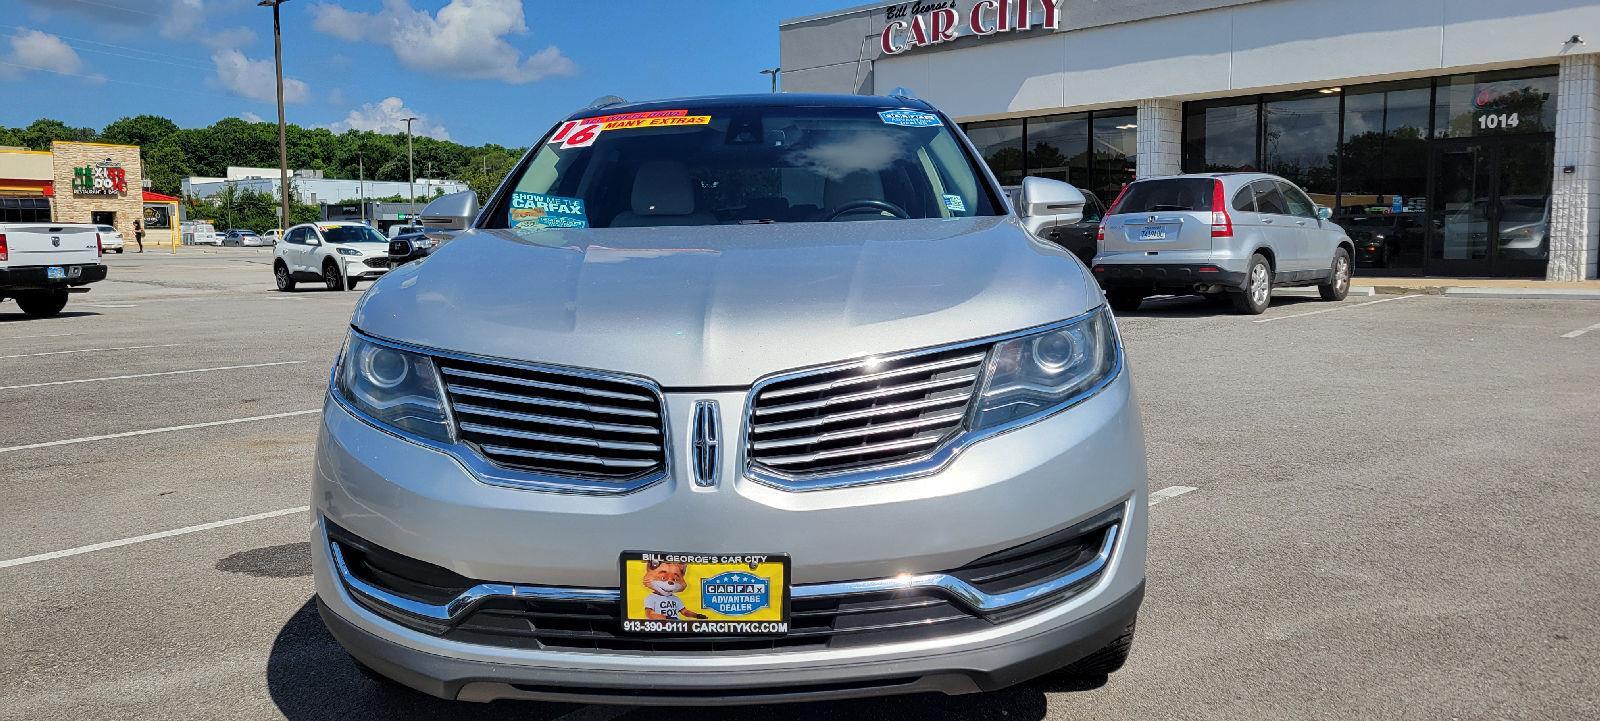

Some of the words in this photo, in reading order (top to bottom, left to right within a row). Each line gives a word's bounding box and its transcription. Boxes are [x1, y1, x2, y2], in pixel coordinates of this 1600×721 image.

[886, 4, 908, 20] Bill
[880, 8, 960, 55] CAR
[969, 0, 1064, 35] CITY
[605, 119, 645, 129] MANY
[649, 116, 706, 125] EXTRAS
[1478, 112, 1519, 130] 1014
[552, 121, 600, 146] 16
[511, 193, 544, 202] SHOW
[546, 197, 561, 205] ME
[511, 199, 583, 215] CARFAX
[642, 553, 664, 562] BILL
[666, 555, 719, 564] GEORGE'S
[721, 555, 744, 564] CAR
[745, 555, 768, 563] CITY
[706, 584, 765, 595] CARFAX
[659, 601, 677, 609] CAR
[711, 595, 761, 603] ADVANTAGE
[660, 609, 678, 617] FOX
[719, 603, 753, 612] DEALER
[623, 620, 689, 632] 913-390-0111
[691, 622, 788, 633] CARCITYKC.COM
